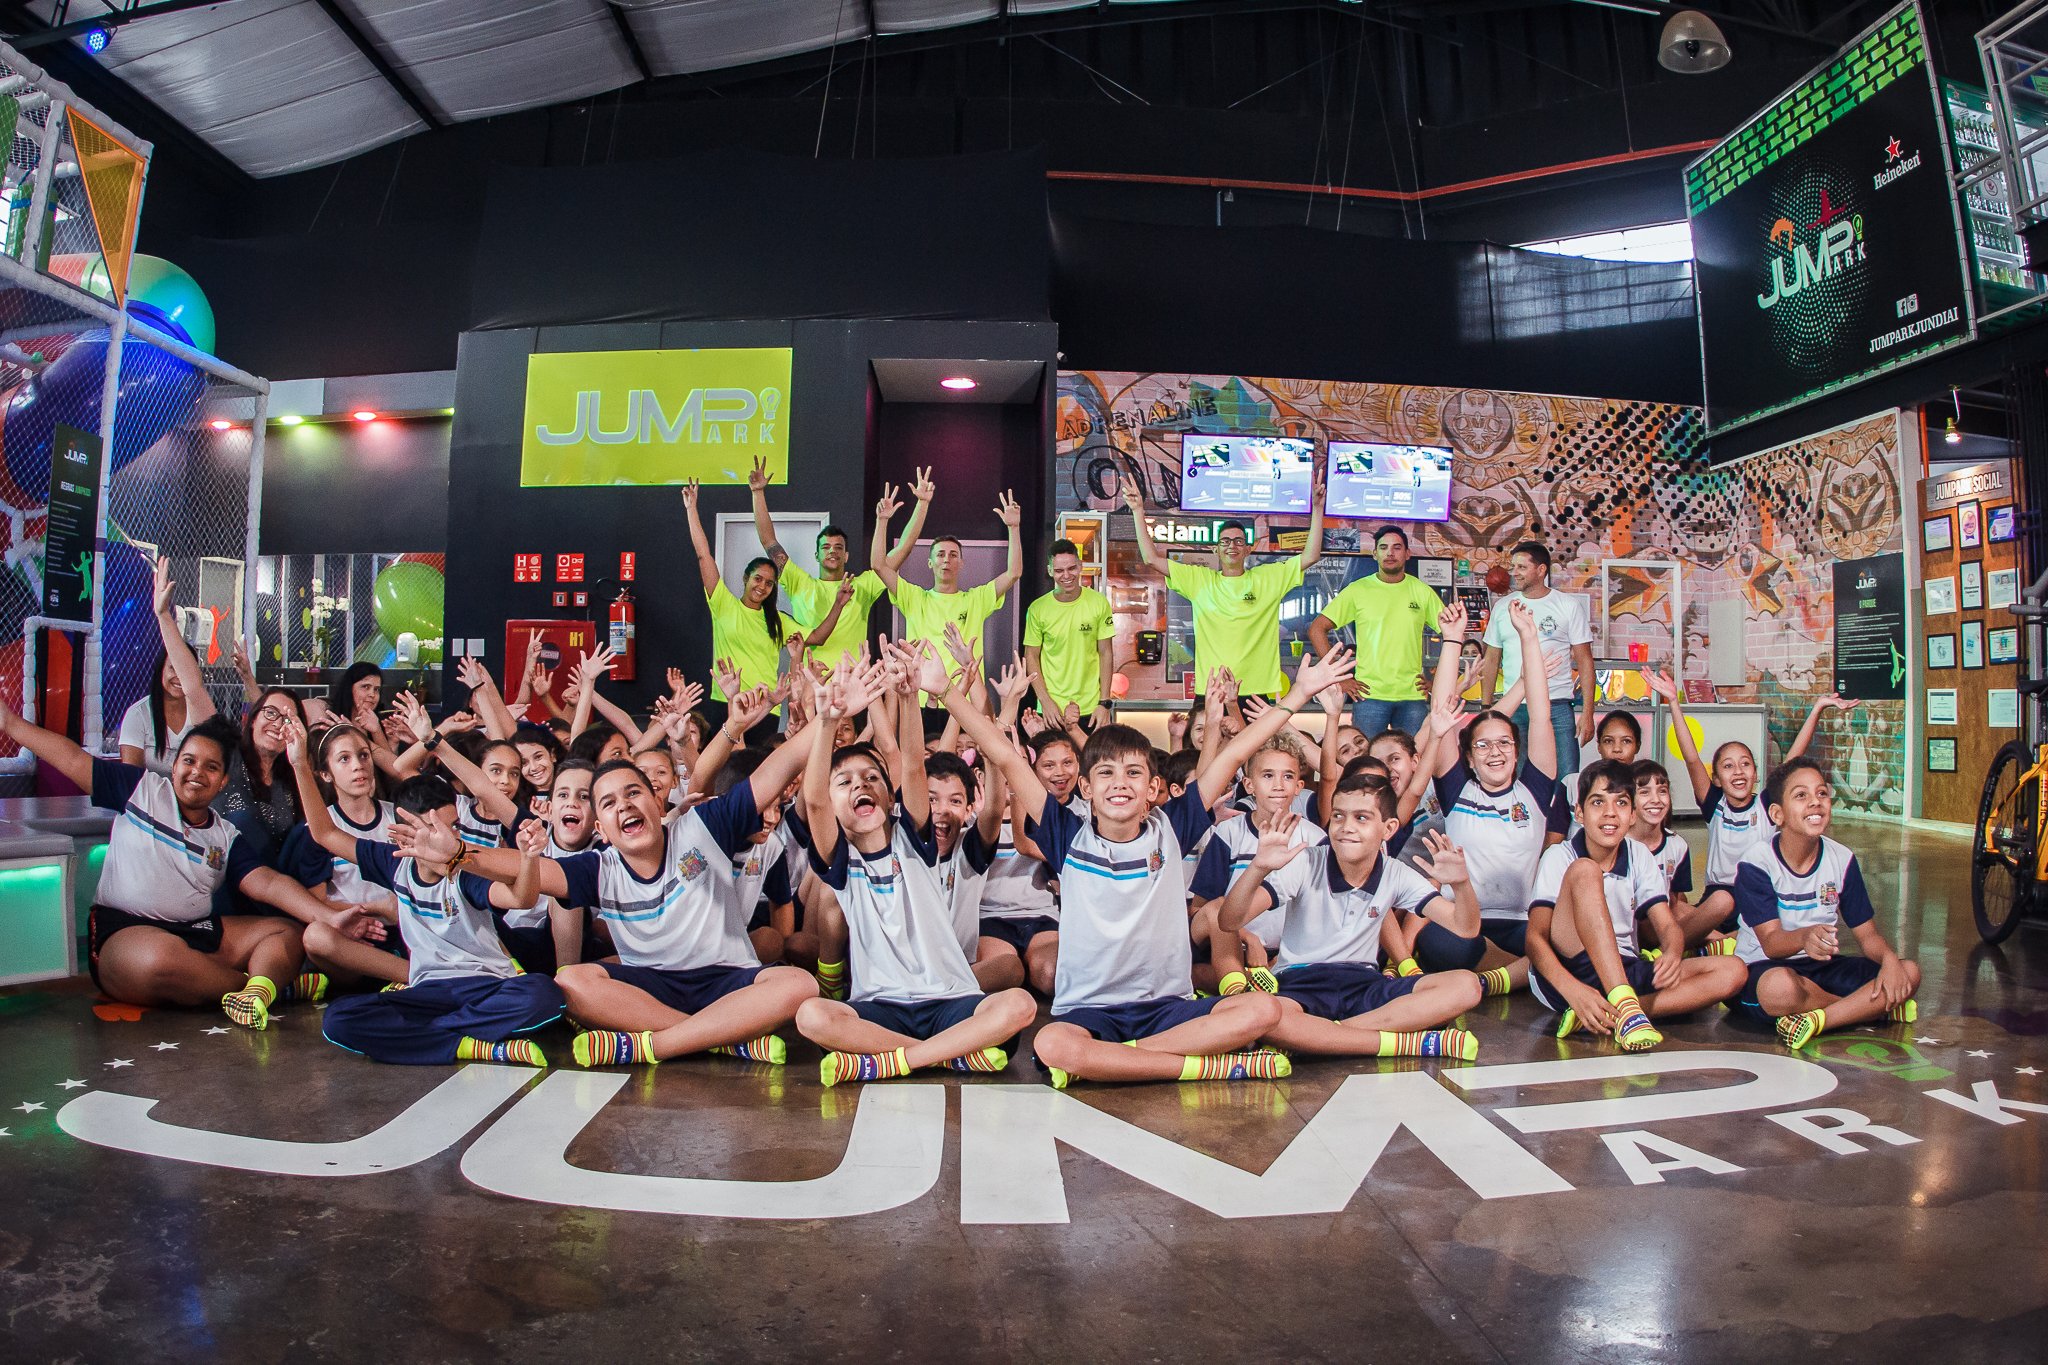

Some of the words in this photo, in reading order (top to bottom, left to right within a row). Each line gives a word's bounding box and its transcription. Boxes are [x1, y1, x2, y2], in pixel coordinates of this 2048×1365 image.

[1873, 153, 1921, 190] Heineken
[1757, 220, 1855, 309] JUMP
[1833, 241, 1867, 274] ARK
[1869, 307, 1959, 353] JUMPARKJUNDIAI
[536, 388, 758, 446] JUMP
[706, 423, 775, 444] ARK
[1062, 396, 1219, 440] ADRENALINE
[1973, 471, 2003, 493] SOCIAL
[569, 631, 584, 647] H1
[56, 1051, 1839, 1225] JUMP
[1601, 1080, 2048, 1185] ARK
